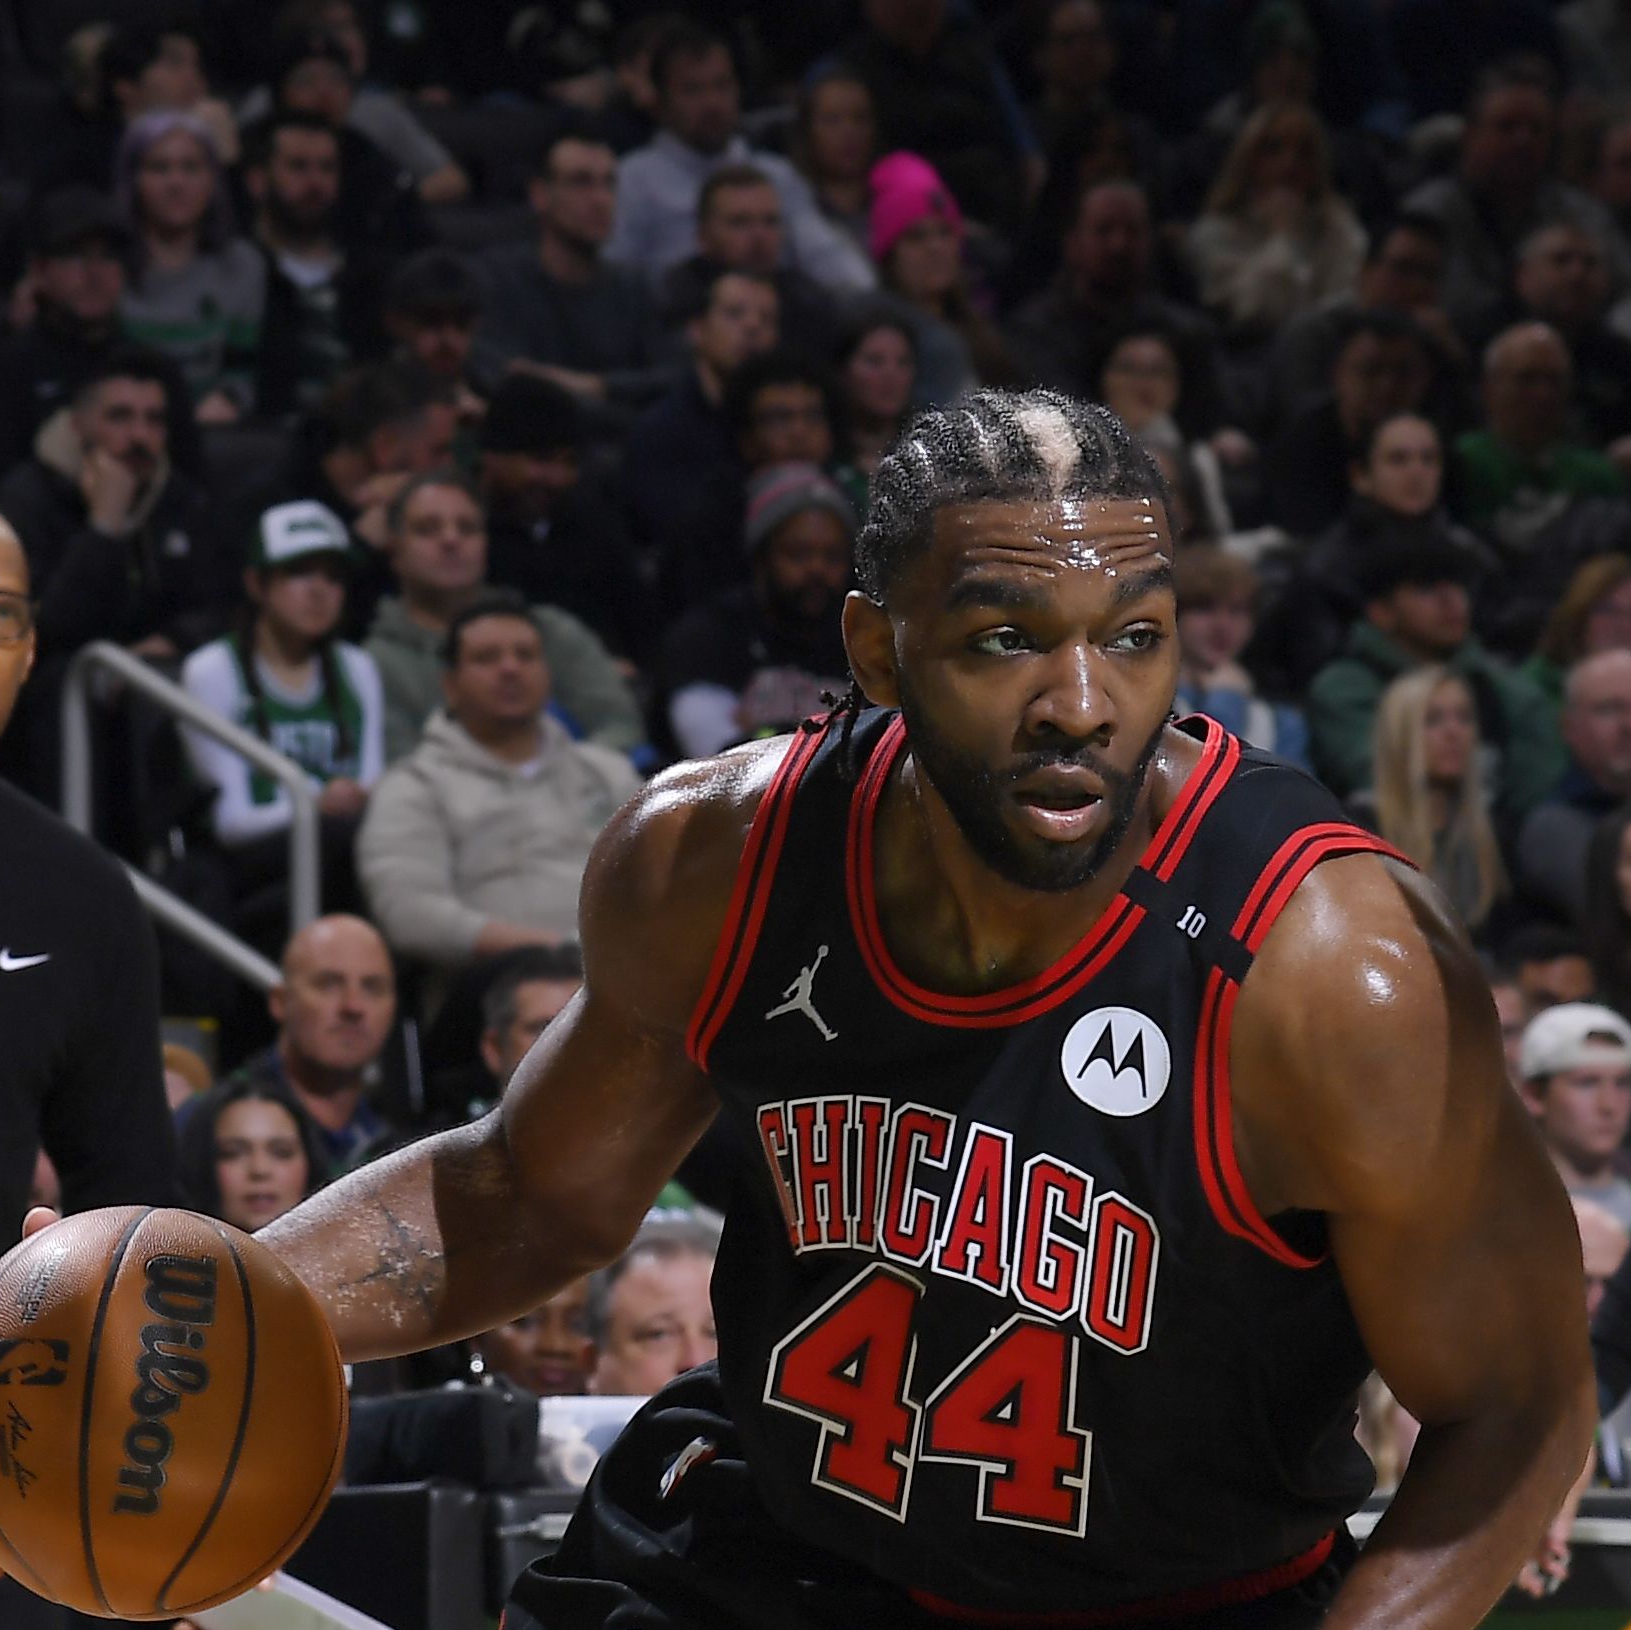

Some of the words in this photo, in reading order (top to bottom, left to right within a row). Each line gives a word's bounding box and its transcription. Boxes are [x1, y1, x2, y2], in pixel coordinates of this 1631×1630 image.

[1176, 905, 1206, 939] 10
[756, 1095, 1161, 1356] CHICAGO
[108, 1254, 219, 1516] Wilson
[763, 1262, 1093, 1540] 44
